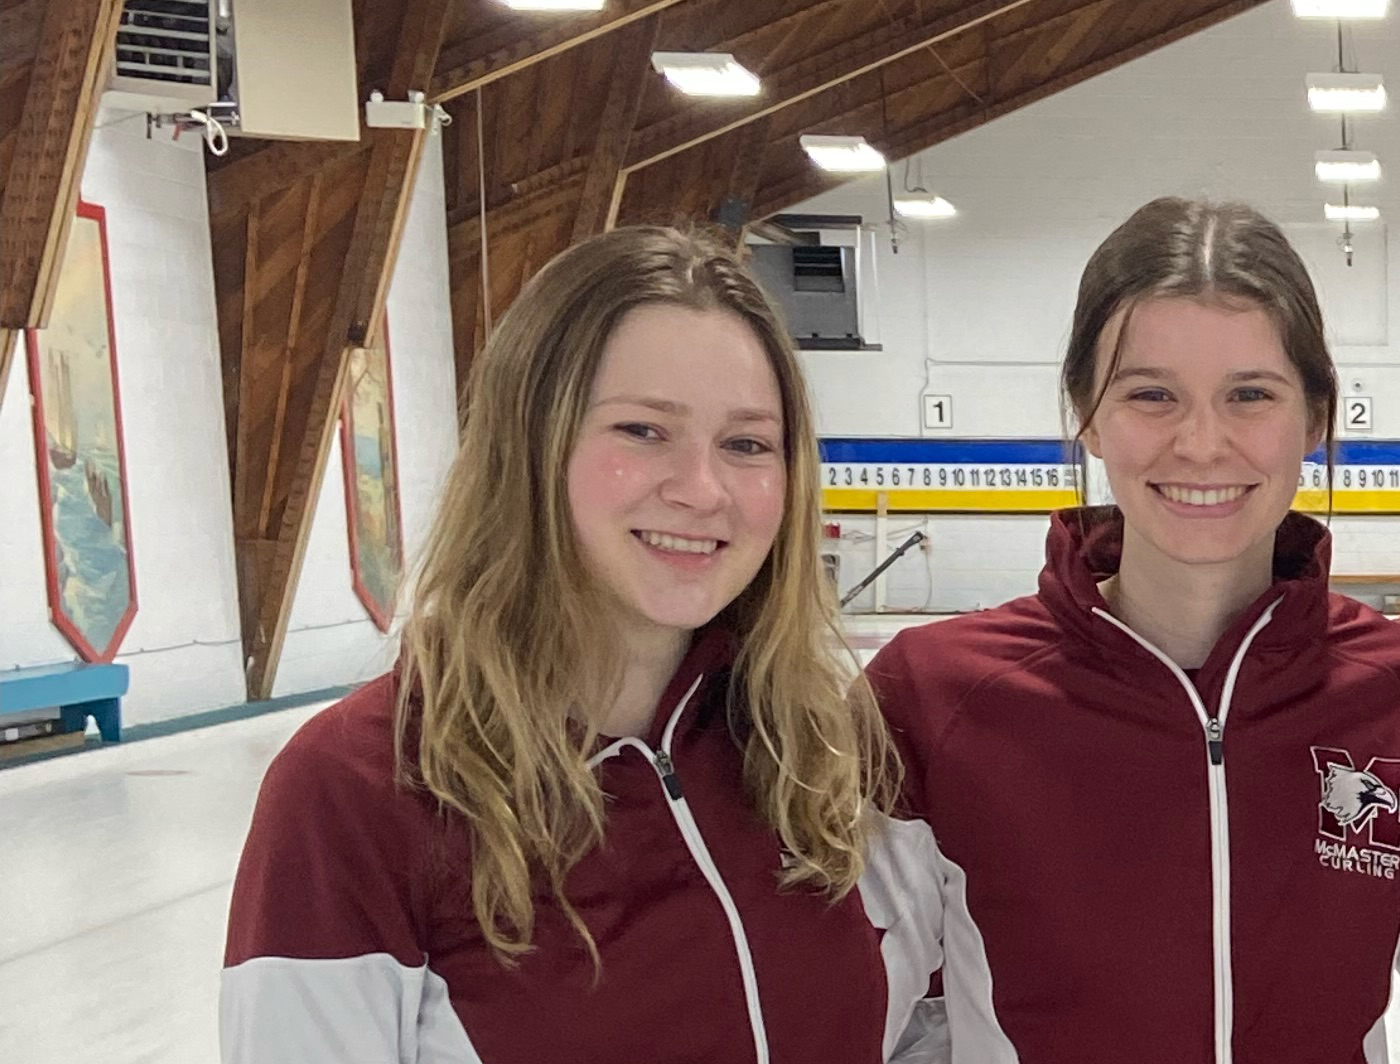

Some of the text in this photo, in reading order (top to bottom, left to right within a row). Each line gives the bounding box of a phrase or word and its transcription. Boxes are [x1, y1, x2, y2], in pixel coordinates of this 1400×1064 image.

[933, 401, 944, 423] 1
[1351, 402, 1366, 424] 2
[829, 467, 837, 486] 2
[844, 467, 852, 486] 3
[860, 467, 868, 486] 4
[876, 467, 884, 486] 5
[892, 467, 900, 486] 6
[907, 467, 915, 486] 7
[923, 468, 931, 487] 8
[939, 468, 947, 487] 9
[953, 468, 965, 487] 10
[969, 468, 980, 487] 11
[984, 468, 996, 487] 12
[999, 468, 1012, 487] 13
[1015, 468, 1027, 487] 14
[1030, 468, 1043, 487] 15
[1046, 468, 1059, 487] 16
[1312, 469, 1320, 487] 6
[1343, 469, 1352, 487] 8
[1359, 469, 1367, 487] 9
[1372, 469, 1385, 487] 10
[1389, 469, 1399, 487] 11
[1314, 839, 1400, 870] McMASTER
[1319, 854, 1395, 879] CURLING
